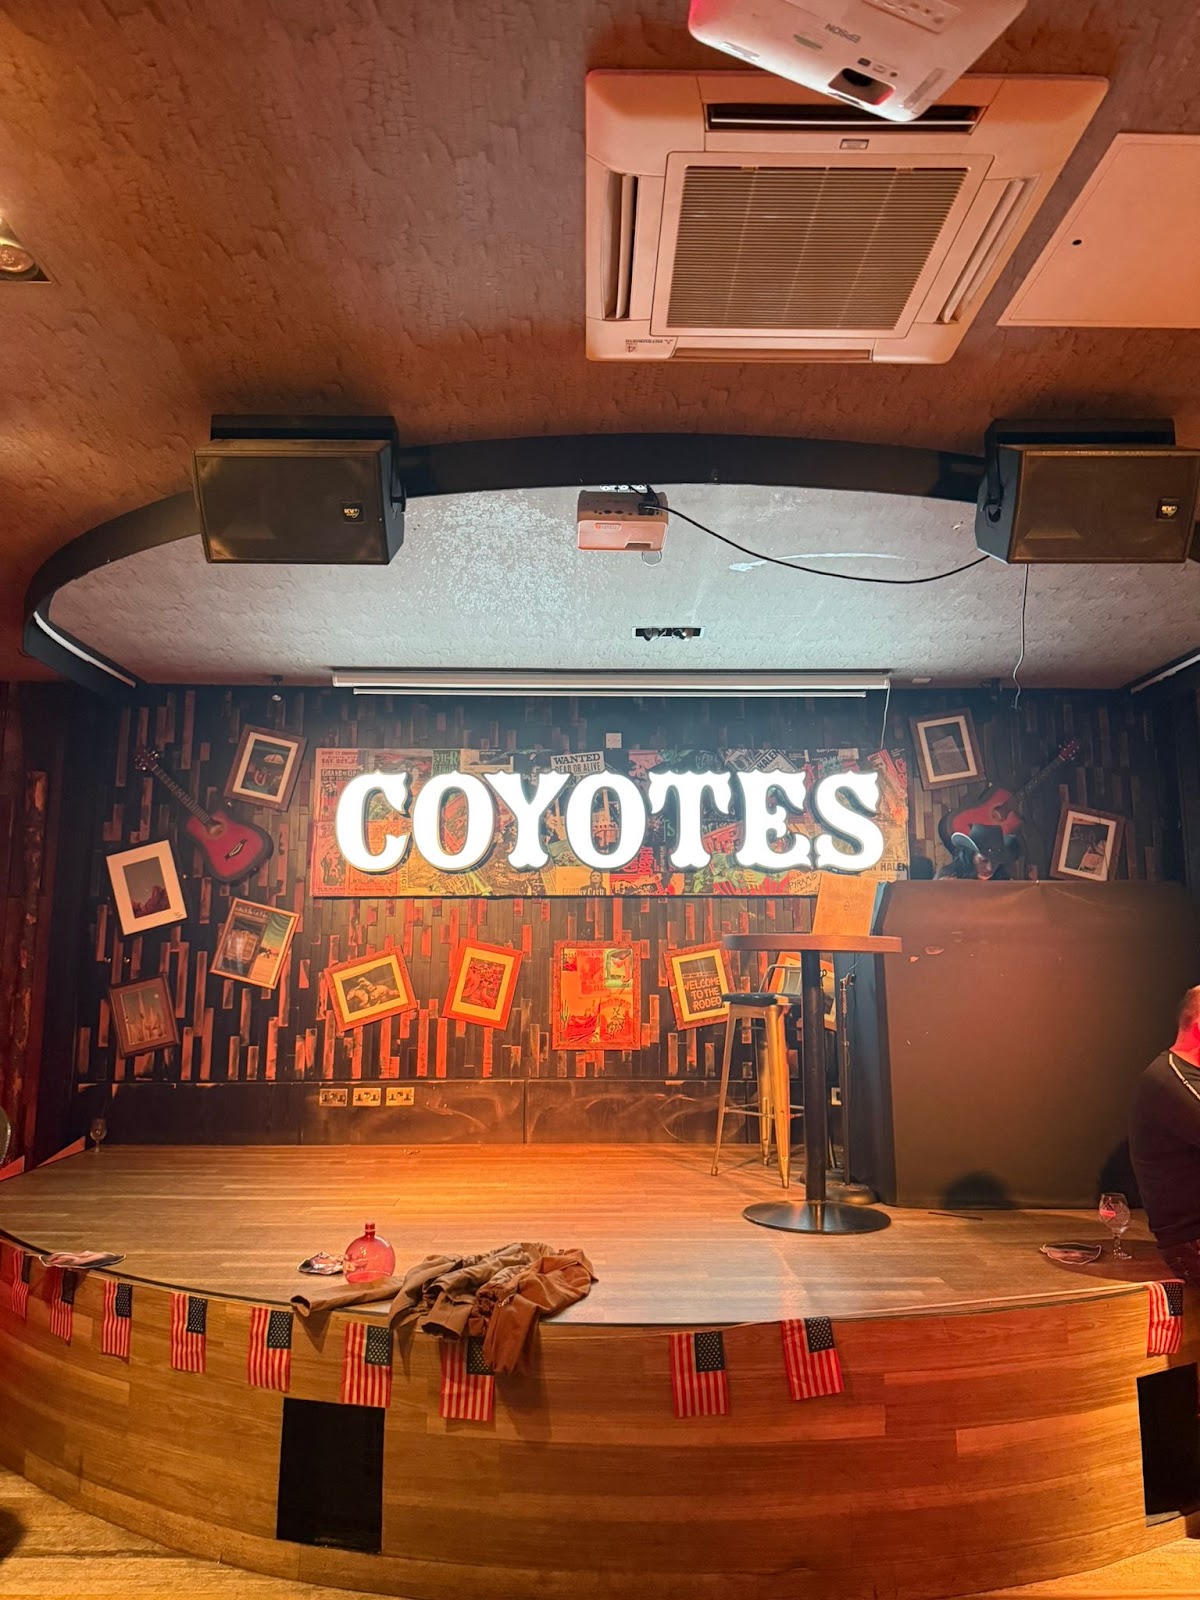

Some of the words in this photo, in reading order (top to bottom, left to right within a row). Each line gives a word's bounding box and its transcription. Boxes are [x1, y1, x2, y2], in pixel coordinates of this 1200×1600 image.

[825, 23, 861, 43] EPSON
[553, 753, 601, 765] WANTED
[583, 761, 601, 772] ALIVE
[336, 769, 885, 870] COYOTES
[880, 862, 908, 872] HALEN
[684, 977, 721, 991] WELCOME
[690, 990, 704, 1001] TO
[703, 986, 721, 997] THE
[692, 996, 722, 1011] RODEO
